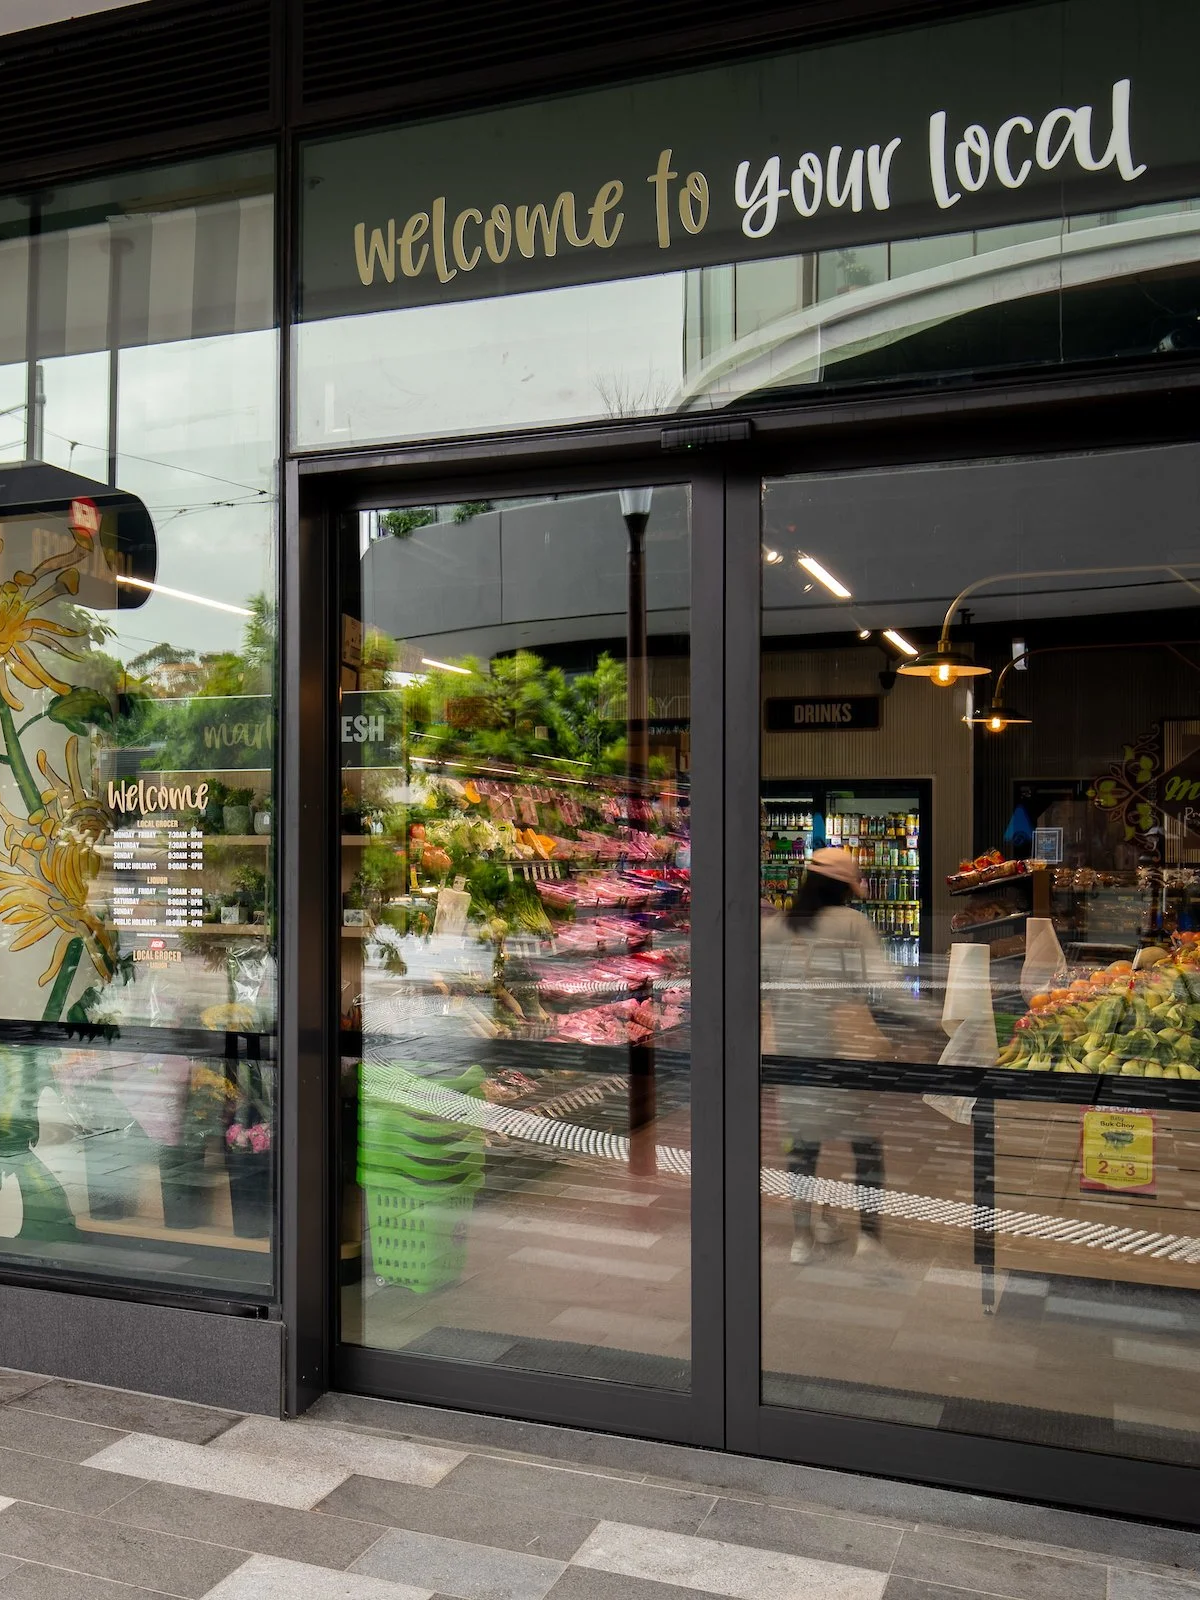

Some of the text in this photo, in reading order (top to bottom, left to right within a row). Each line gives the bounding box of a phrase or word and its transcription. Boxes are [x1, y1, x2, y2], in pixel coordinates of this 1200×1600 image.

[353, 78, 1147, 286] welcome to your local
[793, 703, 852, 724] DRINKS
[204, 713, 272, 750] mar
[341, 715, 385, 742] ESH
[107, 779, 210, 816] Welcome
[137, 820, 179, 828] LOCAL GROCER
[113, 862, 132, 870] PUBLIC
[132, 862, 157, 870] HOLIDAYS
[146, 876, 168, 884] LIQUOR
[138, 887, 157, 895] FRIDAY
[113, 897, 140, 905] SATURDAY
[113, 918, 132, 926] PUBLIC
[132, 918, 157, 926] HOLIDAYS
[133, 949, 182, 963] LOCAL GROCER
[1098, 1160, 1109, 1174] 2
